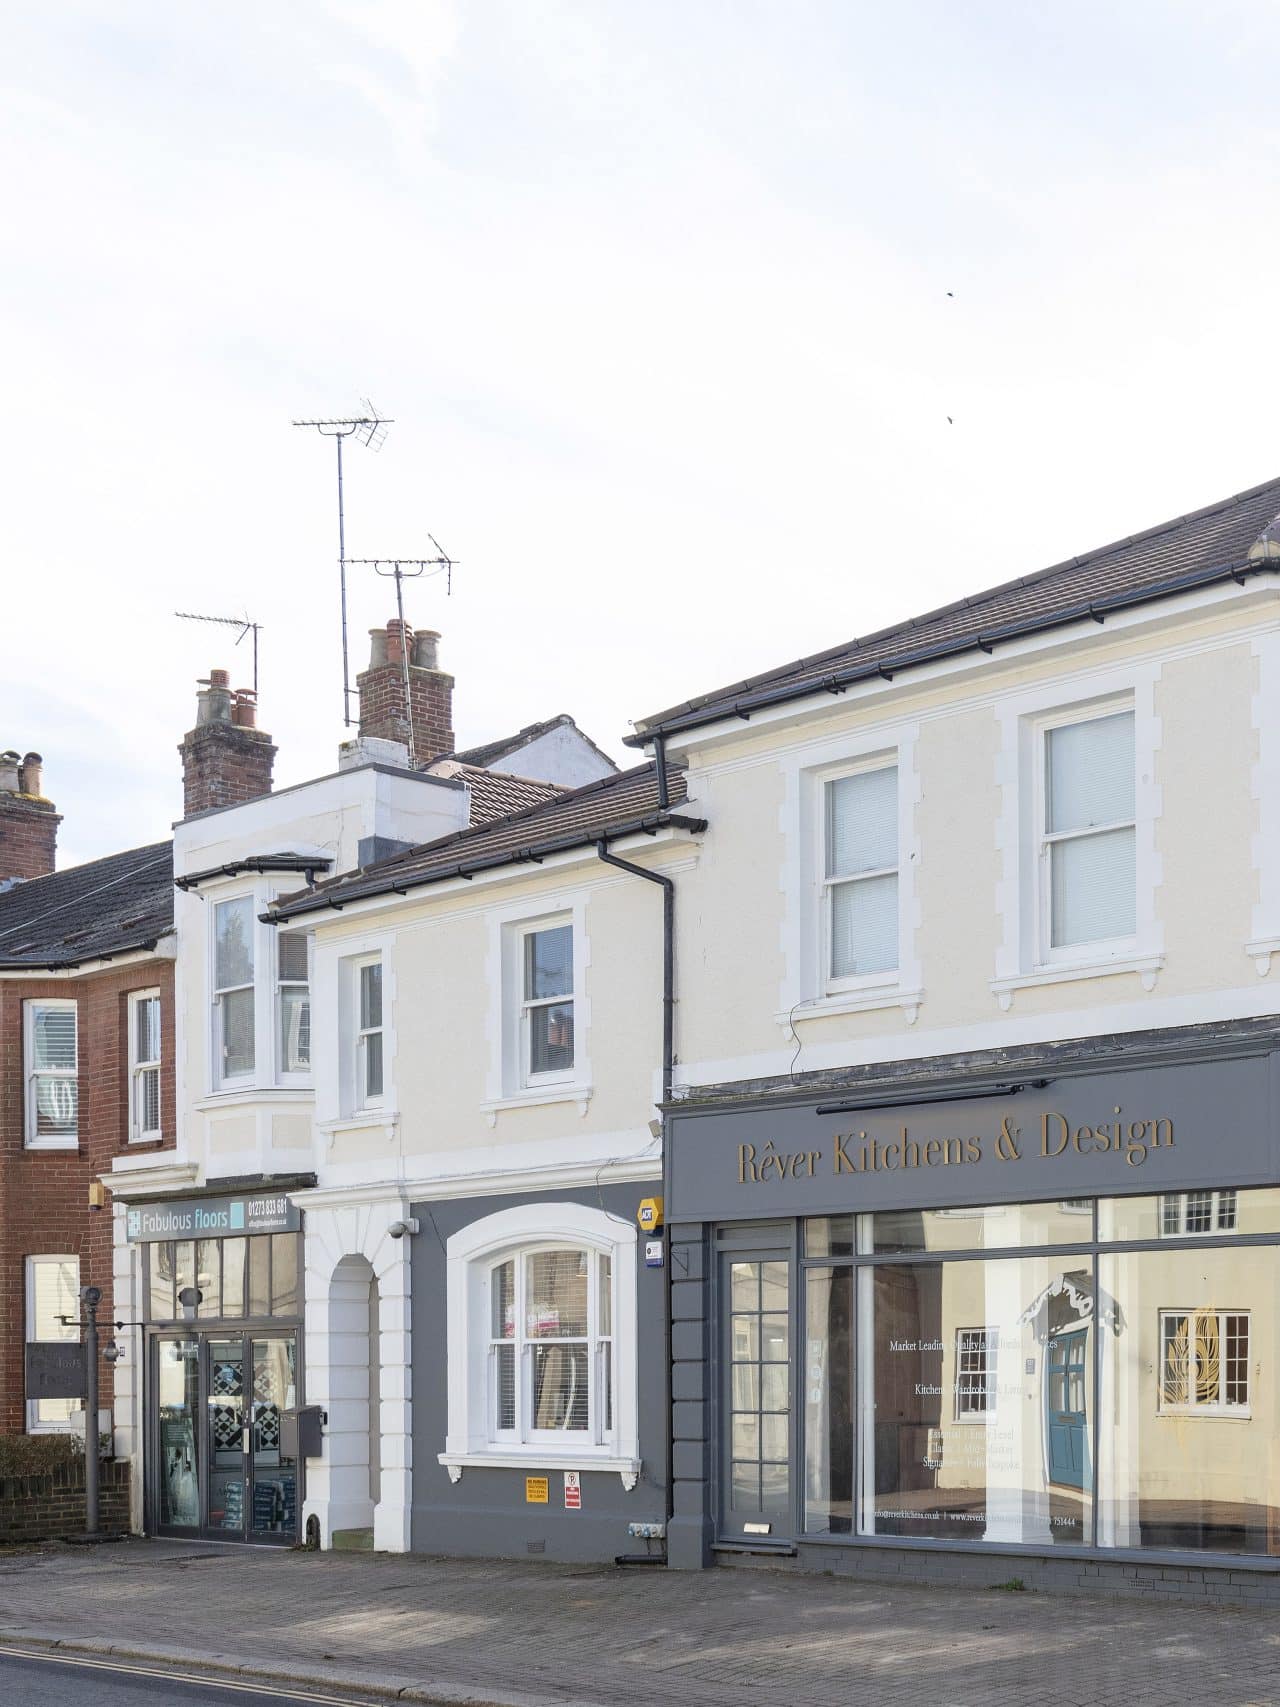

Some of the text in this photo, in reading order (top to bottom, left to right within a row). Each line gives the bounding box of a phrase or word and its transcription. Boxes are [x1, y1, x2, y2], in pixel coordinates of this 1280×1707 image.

[737, 1105, 1176, 1183] Rêver Kitchens & Design
[249, 1200, 265, 1216] 01273
[143, 1210, 192, 1233] Fabulous
[194, 1208, 228, 1229] floors
[890, 1340, 917, 1351] Market
